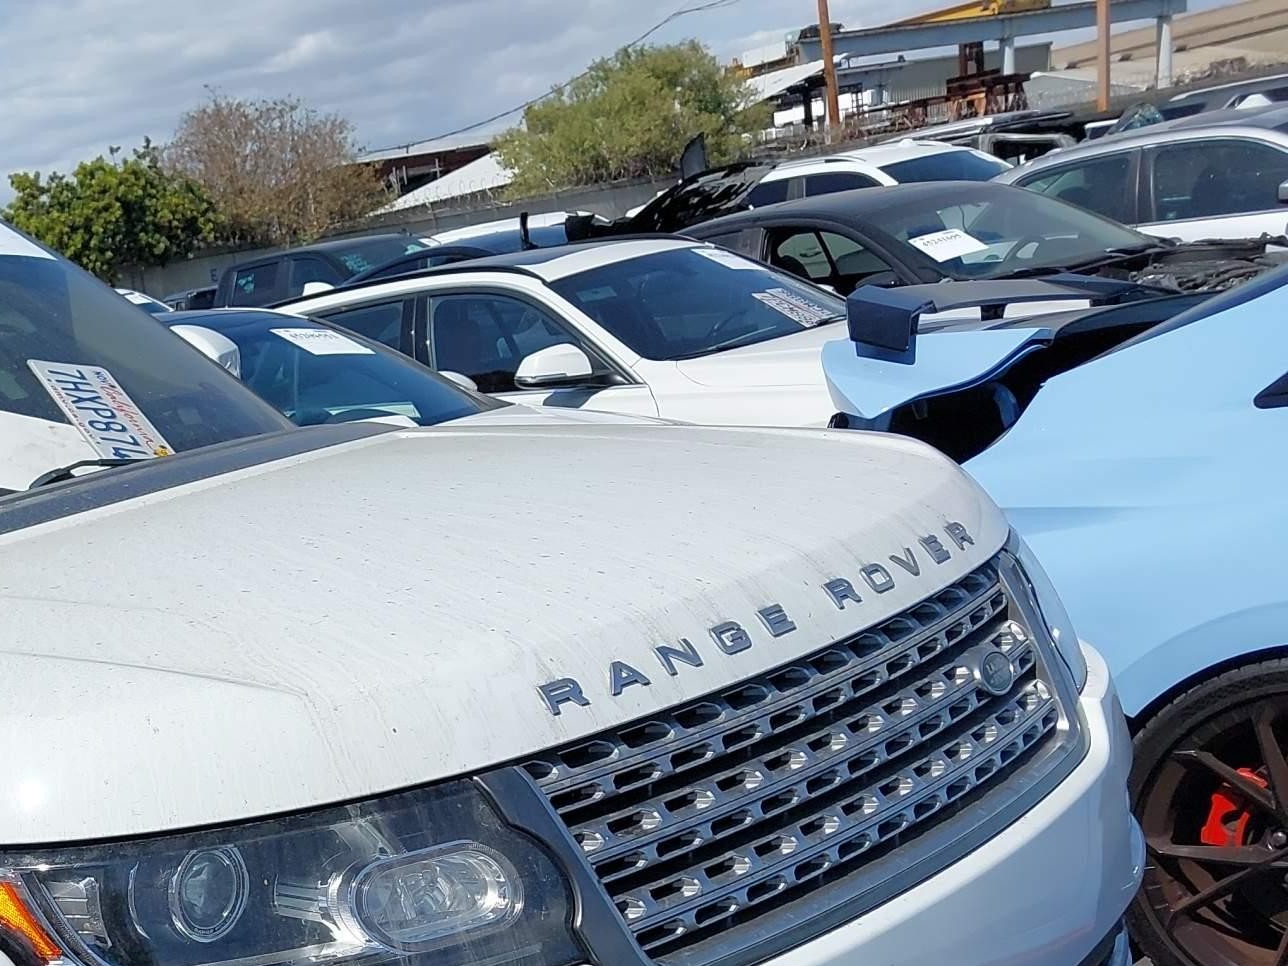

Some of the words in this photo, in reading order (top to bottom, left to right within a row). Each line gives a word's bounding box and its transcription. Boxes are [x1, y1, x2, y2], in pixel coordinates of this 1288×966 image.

[47, 369, 148, 460] 7HXP874
[535, 602, 798, 716] RANGE
[822, 521, 976, 610] ROVER
